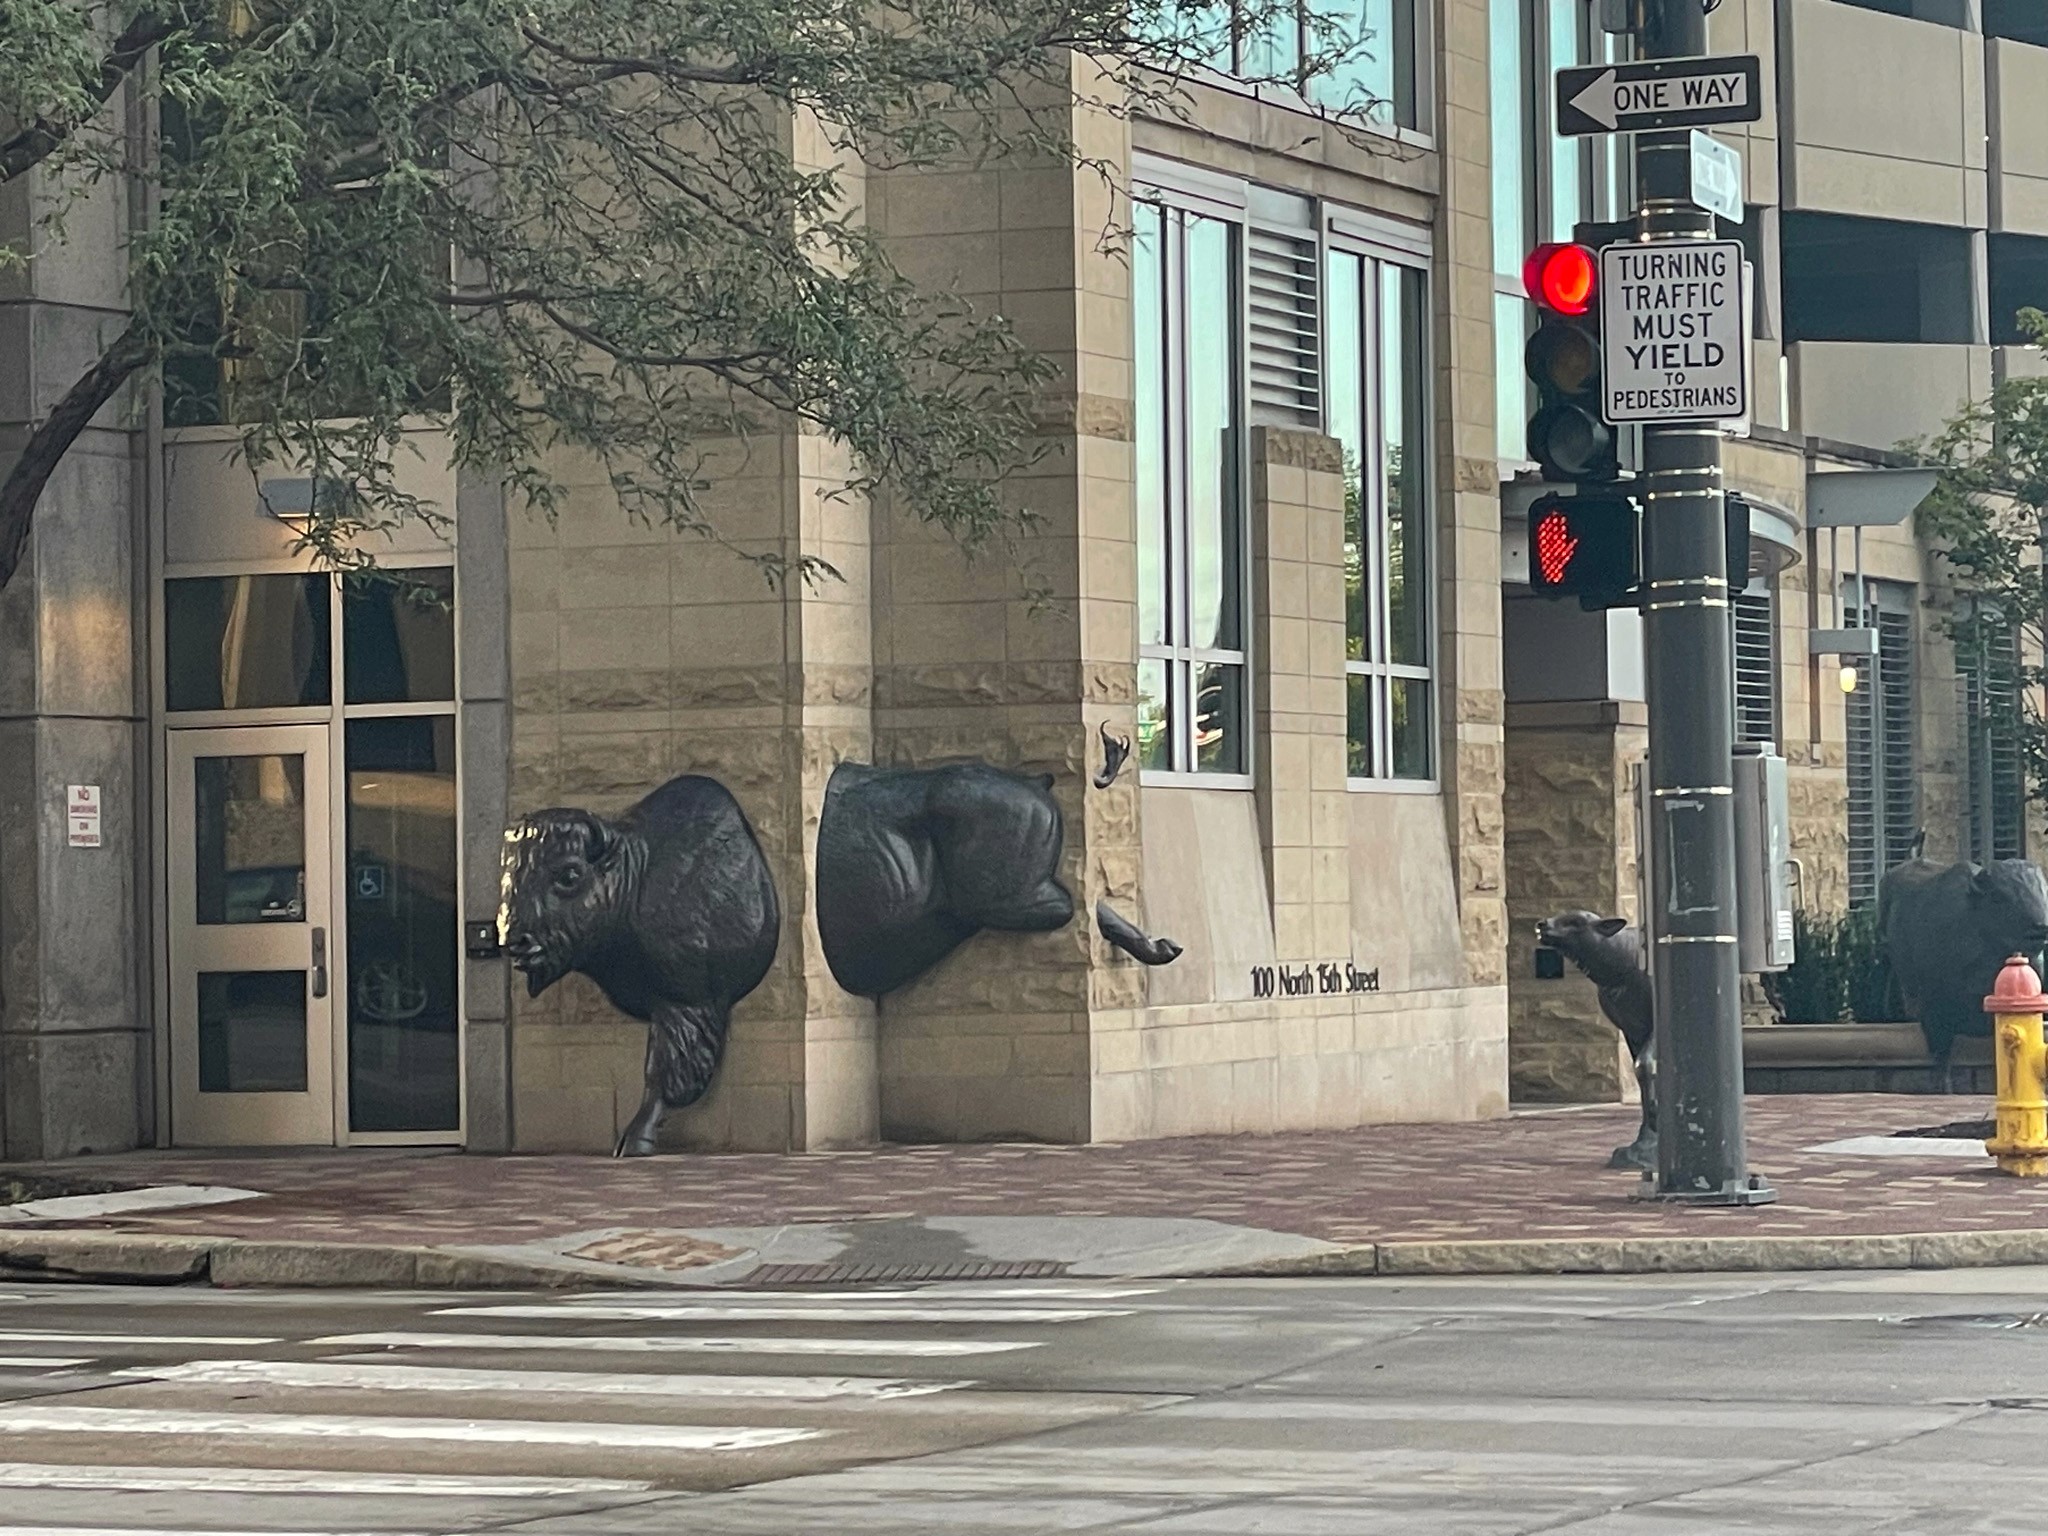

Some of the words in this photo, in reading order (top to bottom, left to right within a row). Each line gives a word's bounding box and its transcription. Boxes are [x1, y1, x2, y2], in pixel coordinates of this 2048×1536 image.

[1614, 85, 1669, 111] ONE
[1682, 77, 1740, 106] WAY
[1618, 252, 1726, 281] TURNING
[1621, 282, 1724, 311] TRAFFIC
[1633, 312, 1713, 340] MUST
[1625, 342, 1724, 370] YIELD
[1664, 372, 1686, 386] TO
[1614, 386, 1737, 410] PEDESTRIANS
[78, 788, 90, 801] NO
[1250, 965, 1275, 997] 100
[1278, 963, 1314, 996] North
[1316, 962, 1342, 994] 15th
[1346, 963, 1380, 993] Street
